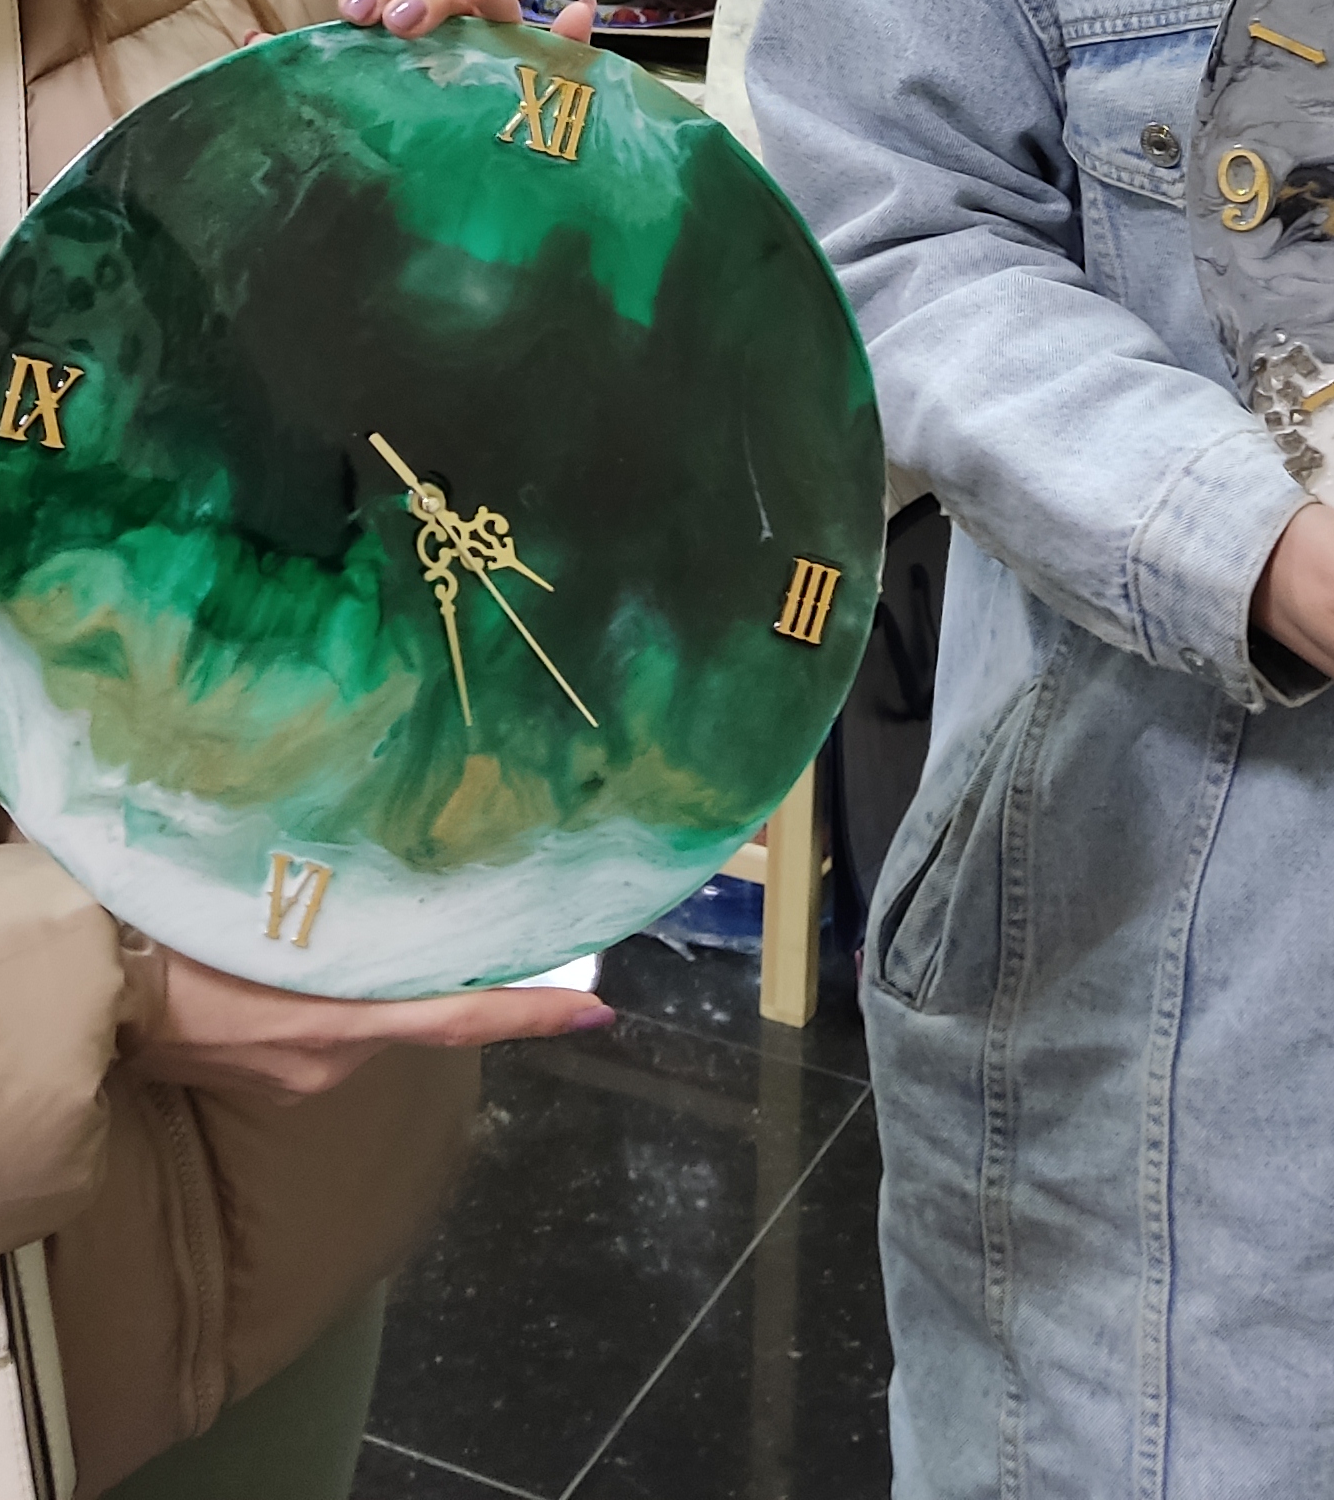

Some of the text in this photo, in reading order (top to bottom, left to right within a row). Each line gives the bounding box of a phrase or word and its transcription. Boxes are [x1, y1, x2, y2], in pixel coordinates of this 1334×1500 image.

[497, 66, 596, 162] XII
[1216, 146, 1272, 232] 9
[774, 556, 842, 645] III
[262, 851, 332, 948] VI
